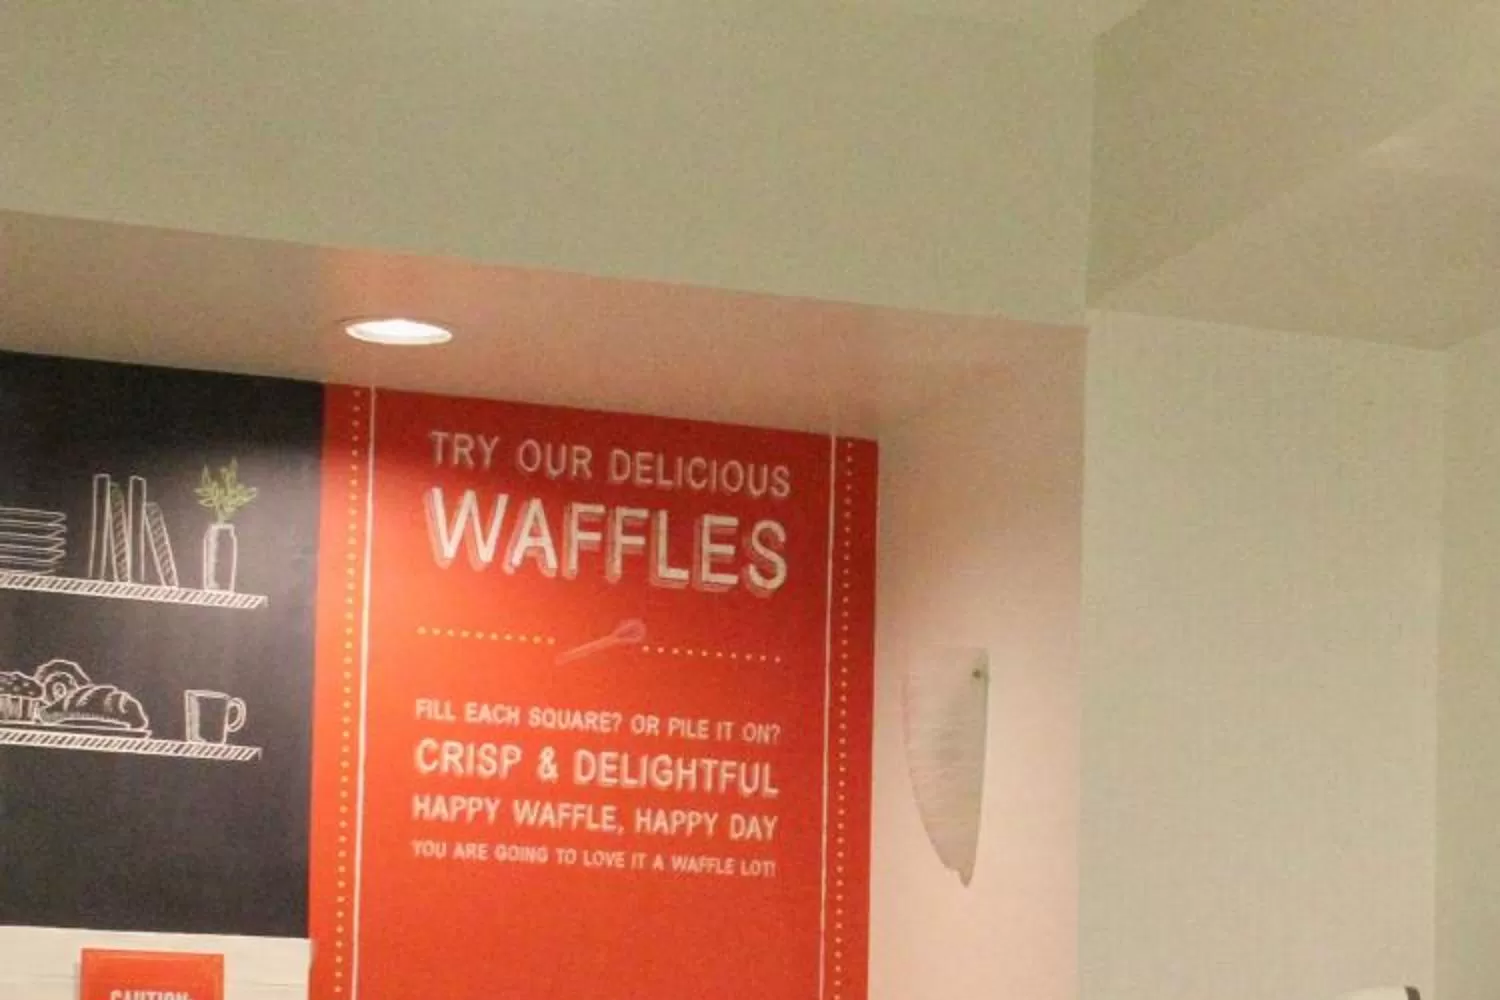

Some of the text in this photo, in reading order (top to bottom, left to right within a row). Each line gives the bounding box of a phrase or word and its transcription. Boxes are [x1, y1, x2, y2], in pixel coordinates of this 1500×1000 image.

[430, 430, 791, 498] TRY OUR DELICIOUS
[425, 486, 788, 597] WAFFLES
[415, 698, 781, 745] FILL EACH SQUARE? OR PILE IT ON?
[414, 738, 780, 797] CRISP & DELIGHTFUL
[412, 795, 779, 842] HAPPY WAFFLE, HAPPY DAY
[411, 840, 447, 859] YOU
[453, 842, 489, 861] ARE
[494, 844, 549, 864] GOING
[555, 847, 578, 865] TO
[583, 850, 625, 869] LOVE
[630, 852, 646, 870] IT
[652, 854, 665, 871] A
[672, 854, 735, 874] WAFFLE
